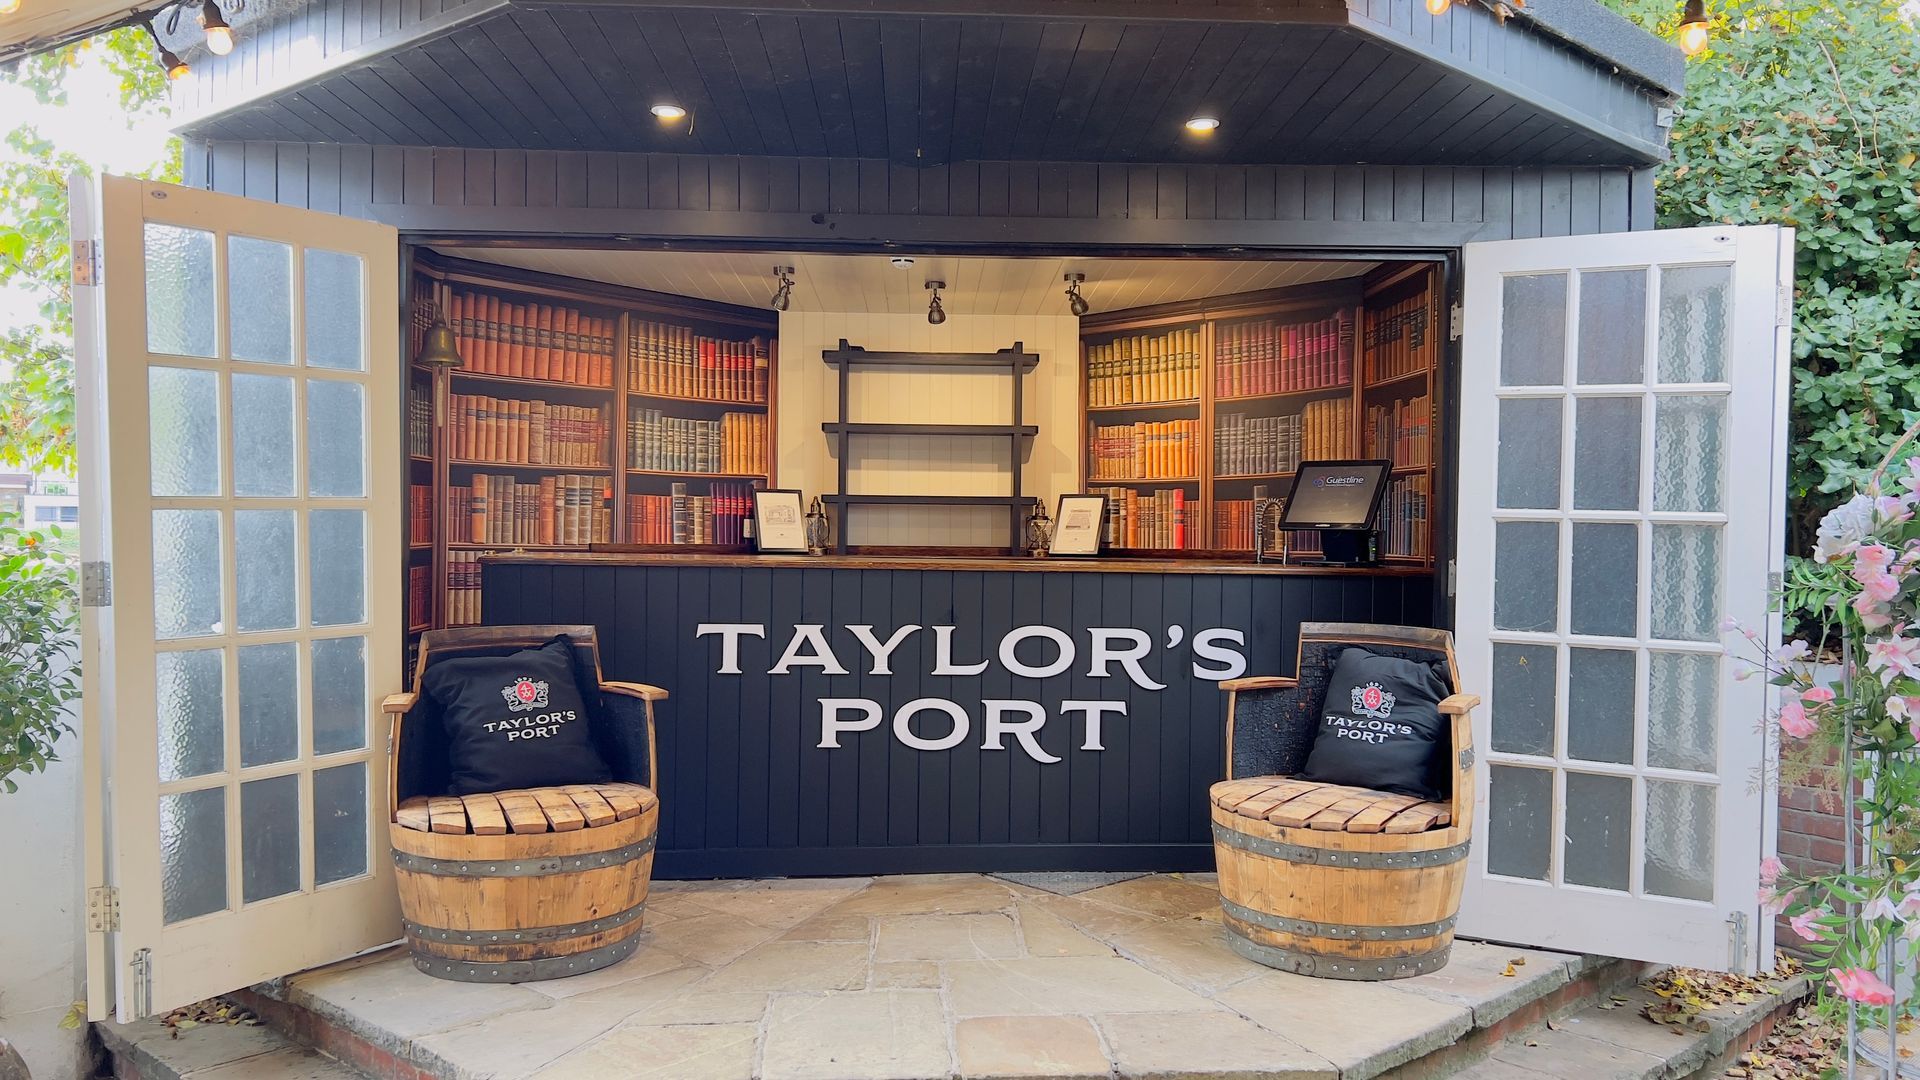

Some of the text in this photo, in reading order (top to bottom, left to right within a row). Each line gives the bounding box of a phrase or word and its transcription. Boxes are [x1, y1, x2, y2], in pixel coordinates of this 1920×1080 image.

[1326, 476, 1364, 484] Guestline
[696, 624, 1247, 691] TAYLOR'S
[483, 710, 576, 733] TAYLOR'S
[815, 697, 1127, 764] PORT
[1325, 716, 1413, 735] TAYLOR'S
[507, 724, 561, 742] PORT
[1336, 728, 1389, 744] PORT
